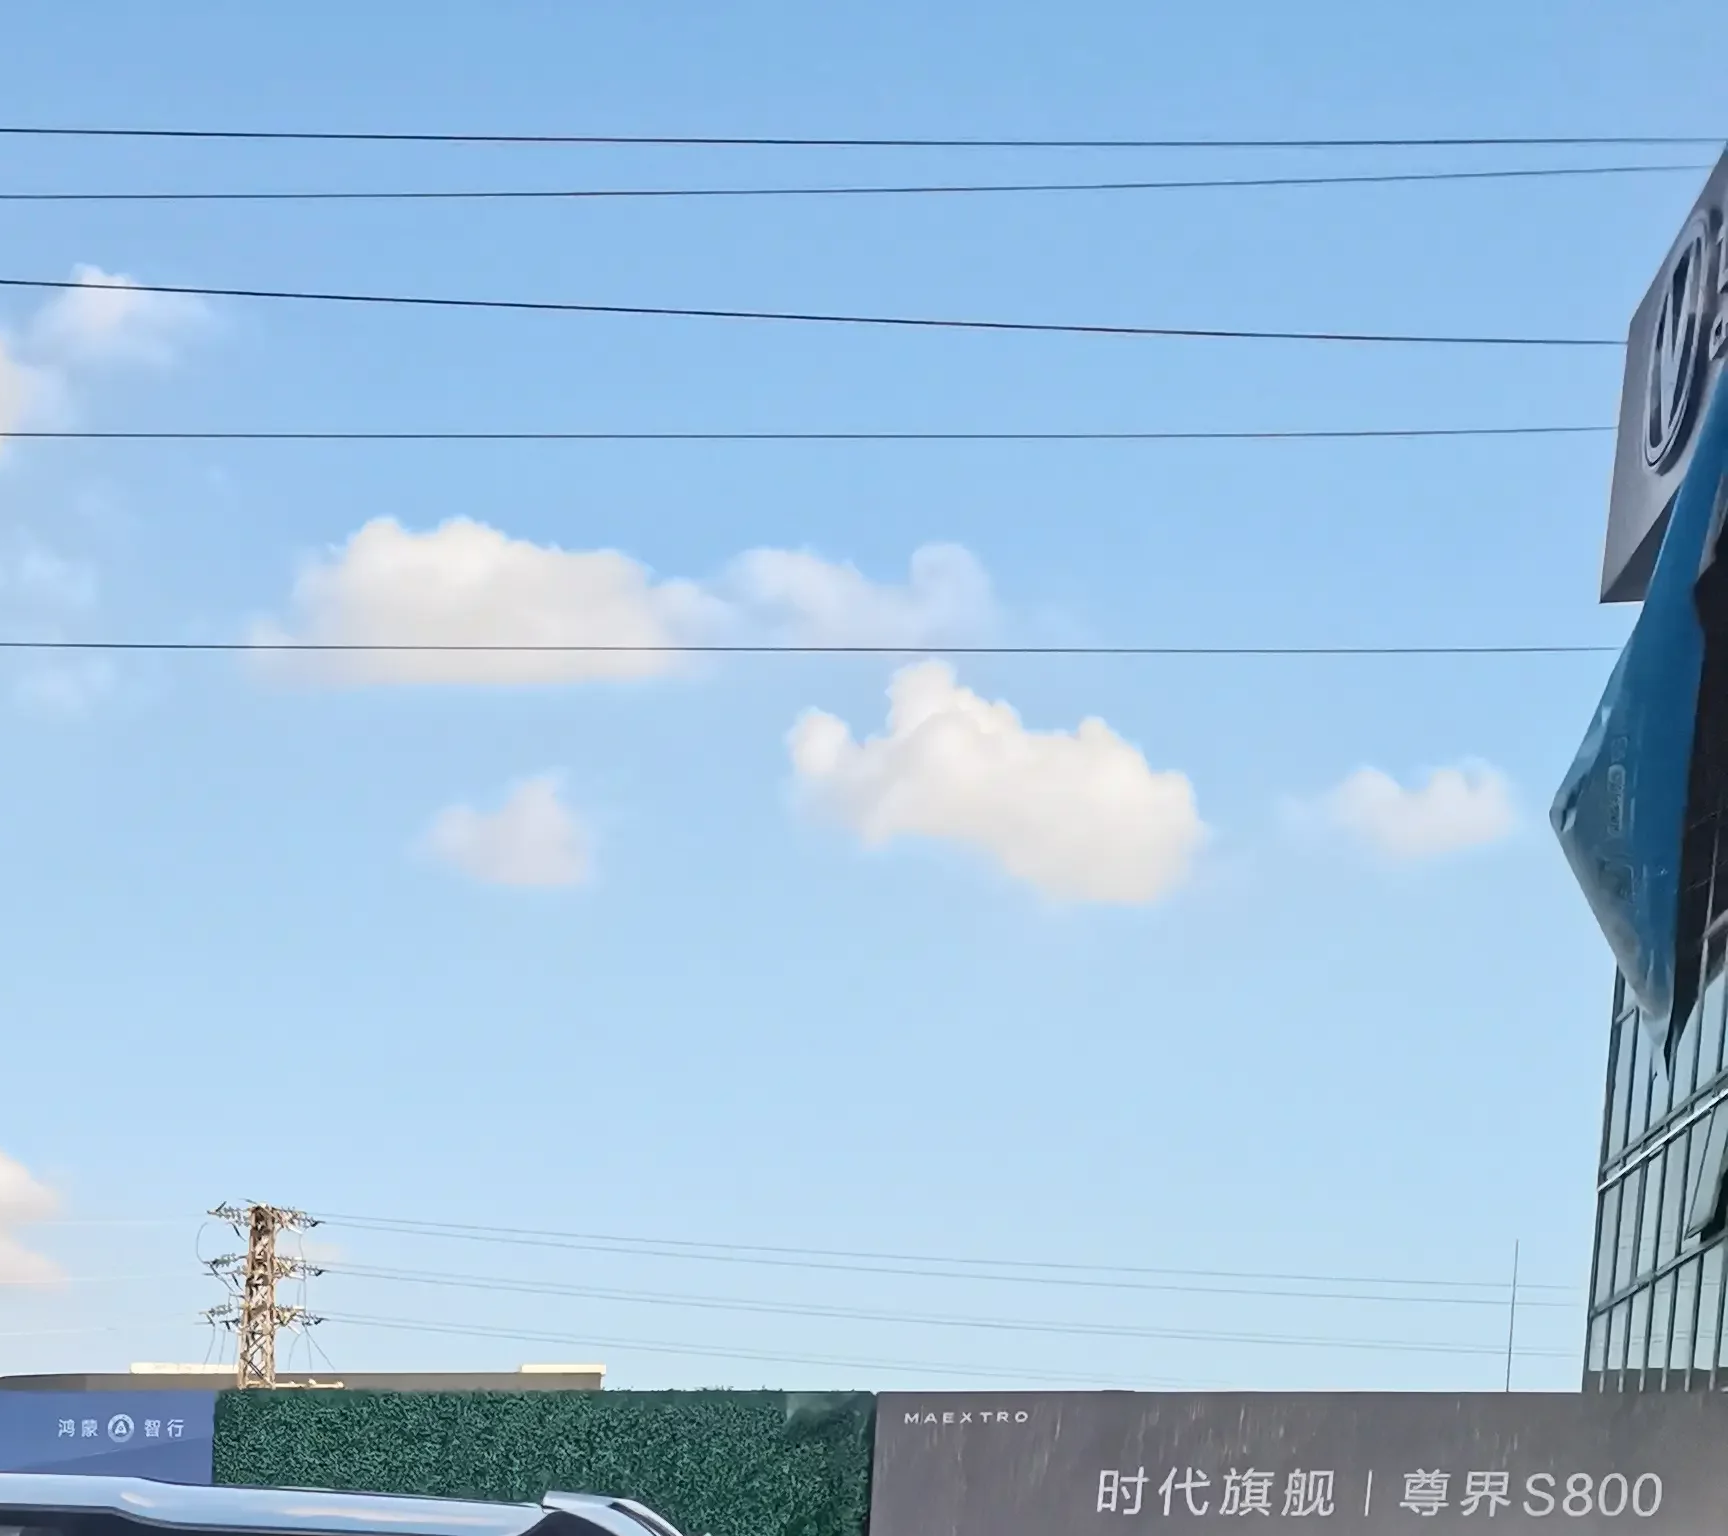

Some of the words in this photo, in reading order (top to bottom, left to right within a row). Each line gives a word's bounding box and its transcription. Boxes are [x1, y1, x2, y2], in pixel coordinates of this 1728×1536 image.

[904, 1411, 1029, 1424] MAEXTRO
[57, 1419, 99, 1437] 鸿蒙
[144, 1419, 185, 1437] 智行
[1096, 1466, 1334, 1516] 时代旗舰
[1399, 1468, 1663, 1517] 尊界S800
